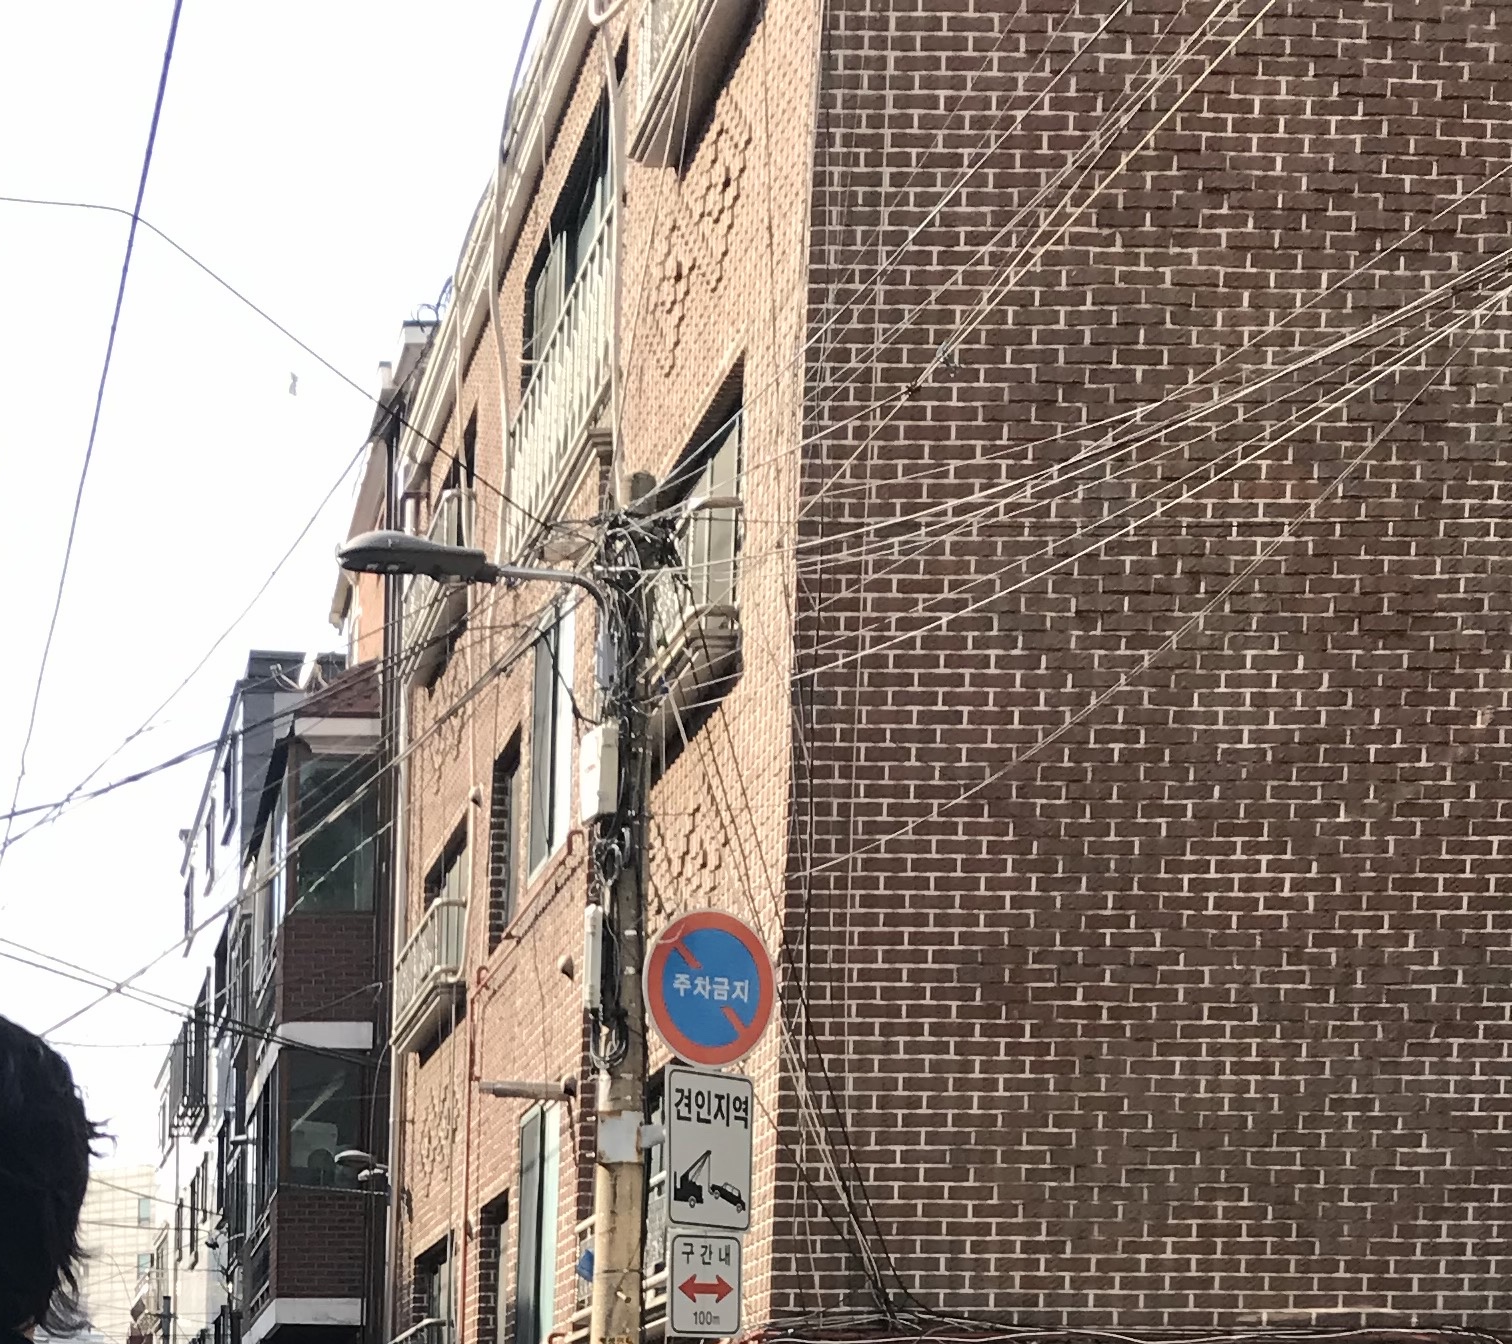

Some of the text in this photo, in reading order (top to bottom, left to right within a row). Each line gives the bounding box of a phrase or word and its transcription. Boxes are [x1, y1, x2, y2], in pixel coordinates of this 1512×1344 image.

[672, 973, 750, 1003] 주차금지
[673, 1086, 750, 1130] 견인지역
[692, 1310, 721, 1326] 100m
